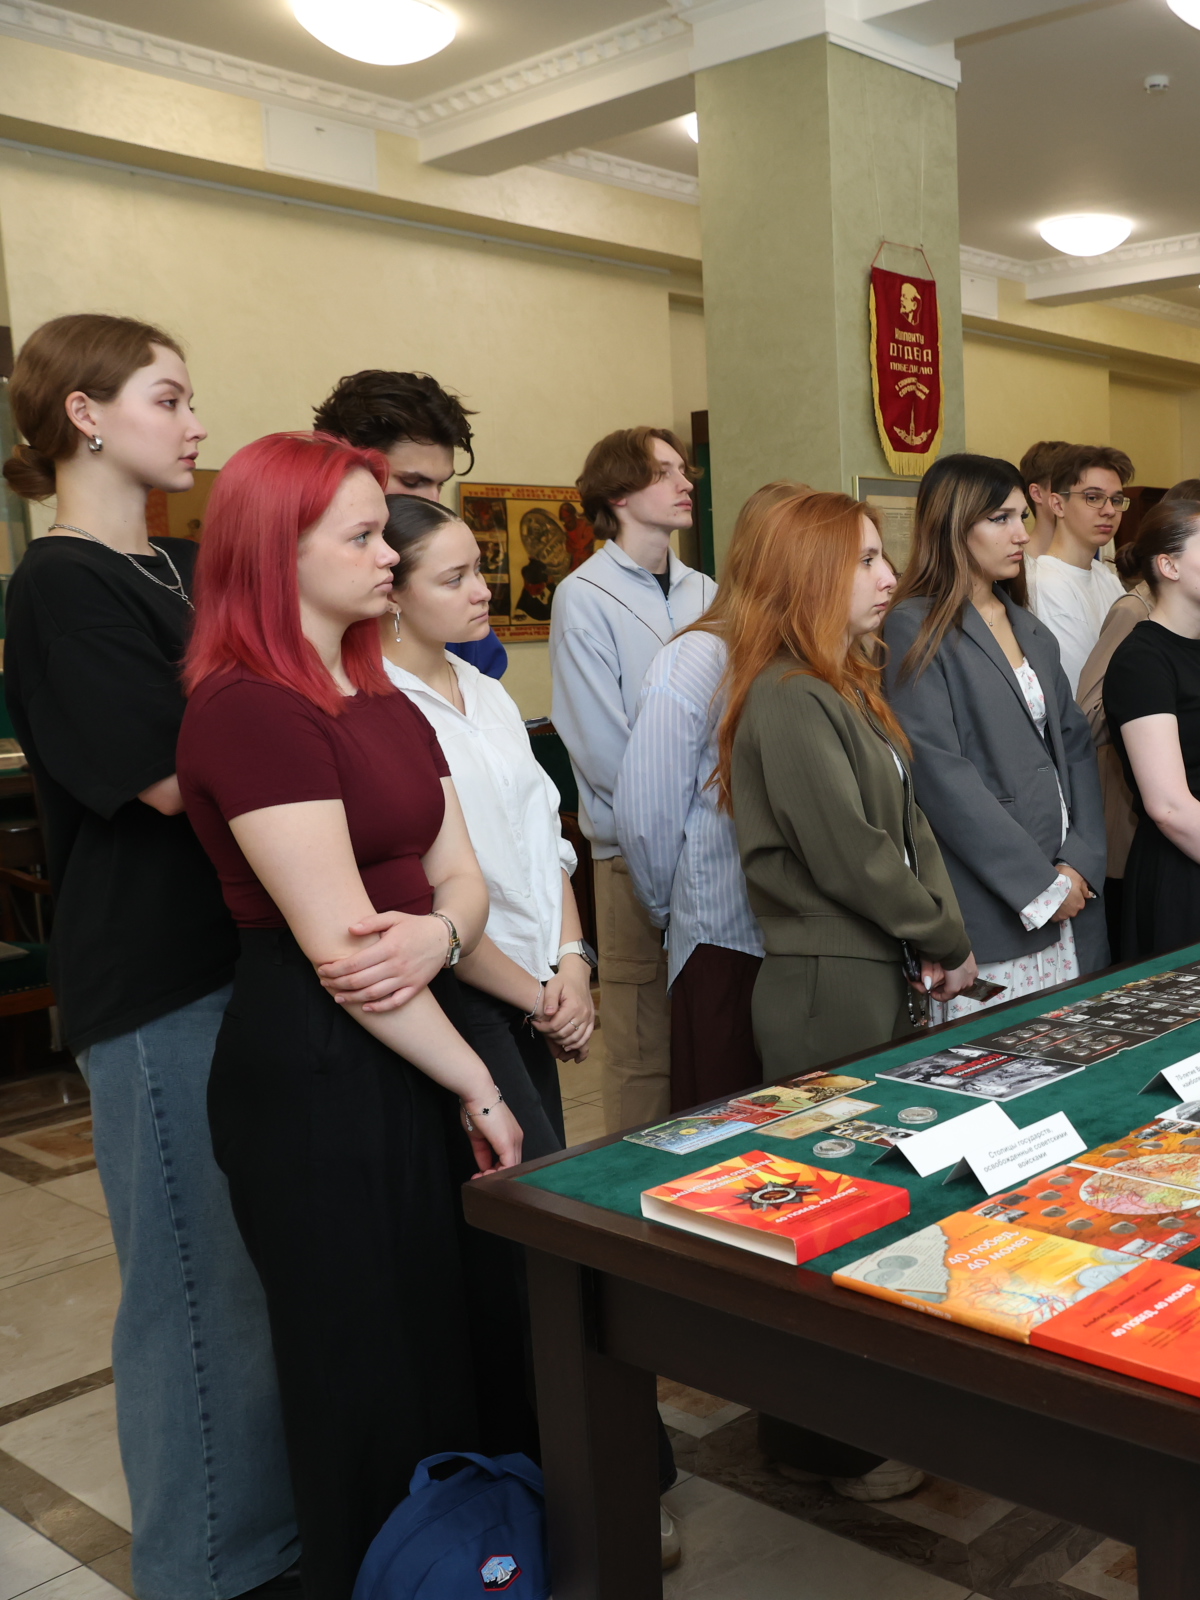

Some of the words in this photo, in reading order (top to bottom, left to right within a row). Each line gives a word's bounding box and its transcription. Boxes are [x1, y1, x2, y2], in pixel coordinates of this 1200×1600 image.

[983, 1147, 1034, 1173] освобожденные
[1033, 1131, 1069, 1150] советскими
[988, 1143, 1017, 1159] Столицы
[1017, 1128, 1053, 1147] государств,
[1017, 1152, 1048, 1169] войсками
[670, 1174, 731, 1199] ЗАЩИТНИКАМ
[729, 1159, 773, 1177] ОТЕЧЕСТВА
[830, 1187, 858, 1200] МОНЕТ
[947, 1253, 971, 1265] 40
[968, 1231, 1021, 1255] побед,
[967, 1258, 991, 1270] 40
[988, 1236, 1034, 1260] монет
[1110, 1328, 1127, 1338] 40
[1121, 1309, 1159, 1330] ПОБЕД,
[1153, 1301, 1169, 1310] 40
[1164, 1283, 1196, 1303] МОНЕТ
